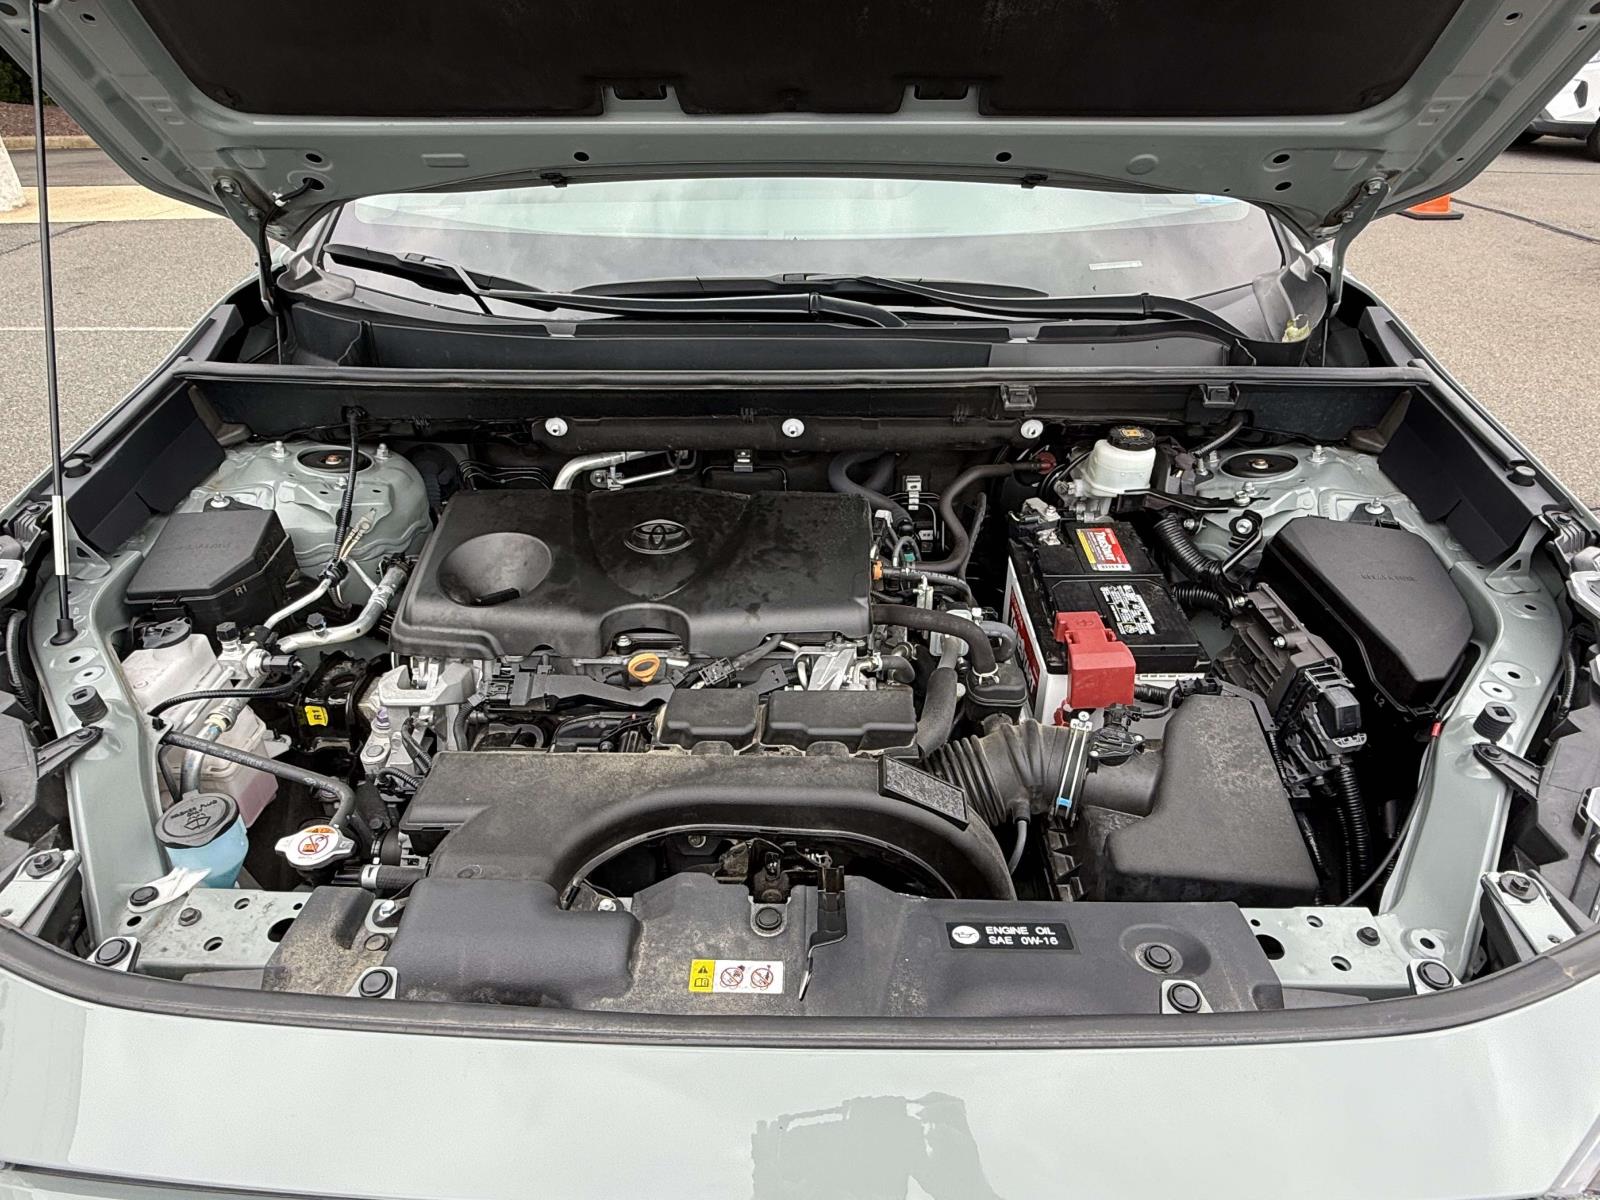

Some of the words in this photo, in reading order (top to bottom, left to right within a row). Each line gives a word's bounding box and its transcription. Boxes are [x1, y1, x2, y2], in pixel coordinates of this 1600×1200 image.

[234, 584, 248, 597] R1
[312, 709, 323, 720] R1
[985, 926, 1029, 935] ENGINE
[1035, 926, 1056, 935] OIL
[988, 936, 1014, 945] SAE
[1020, 936, 1059, 945] 0W-16
